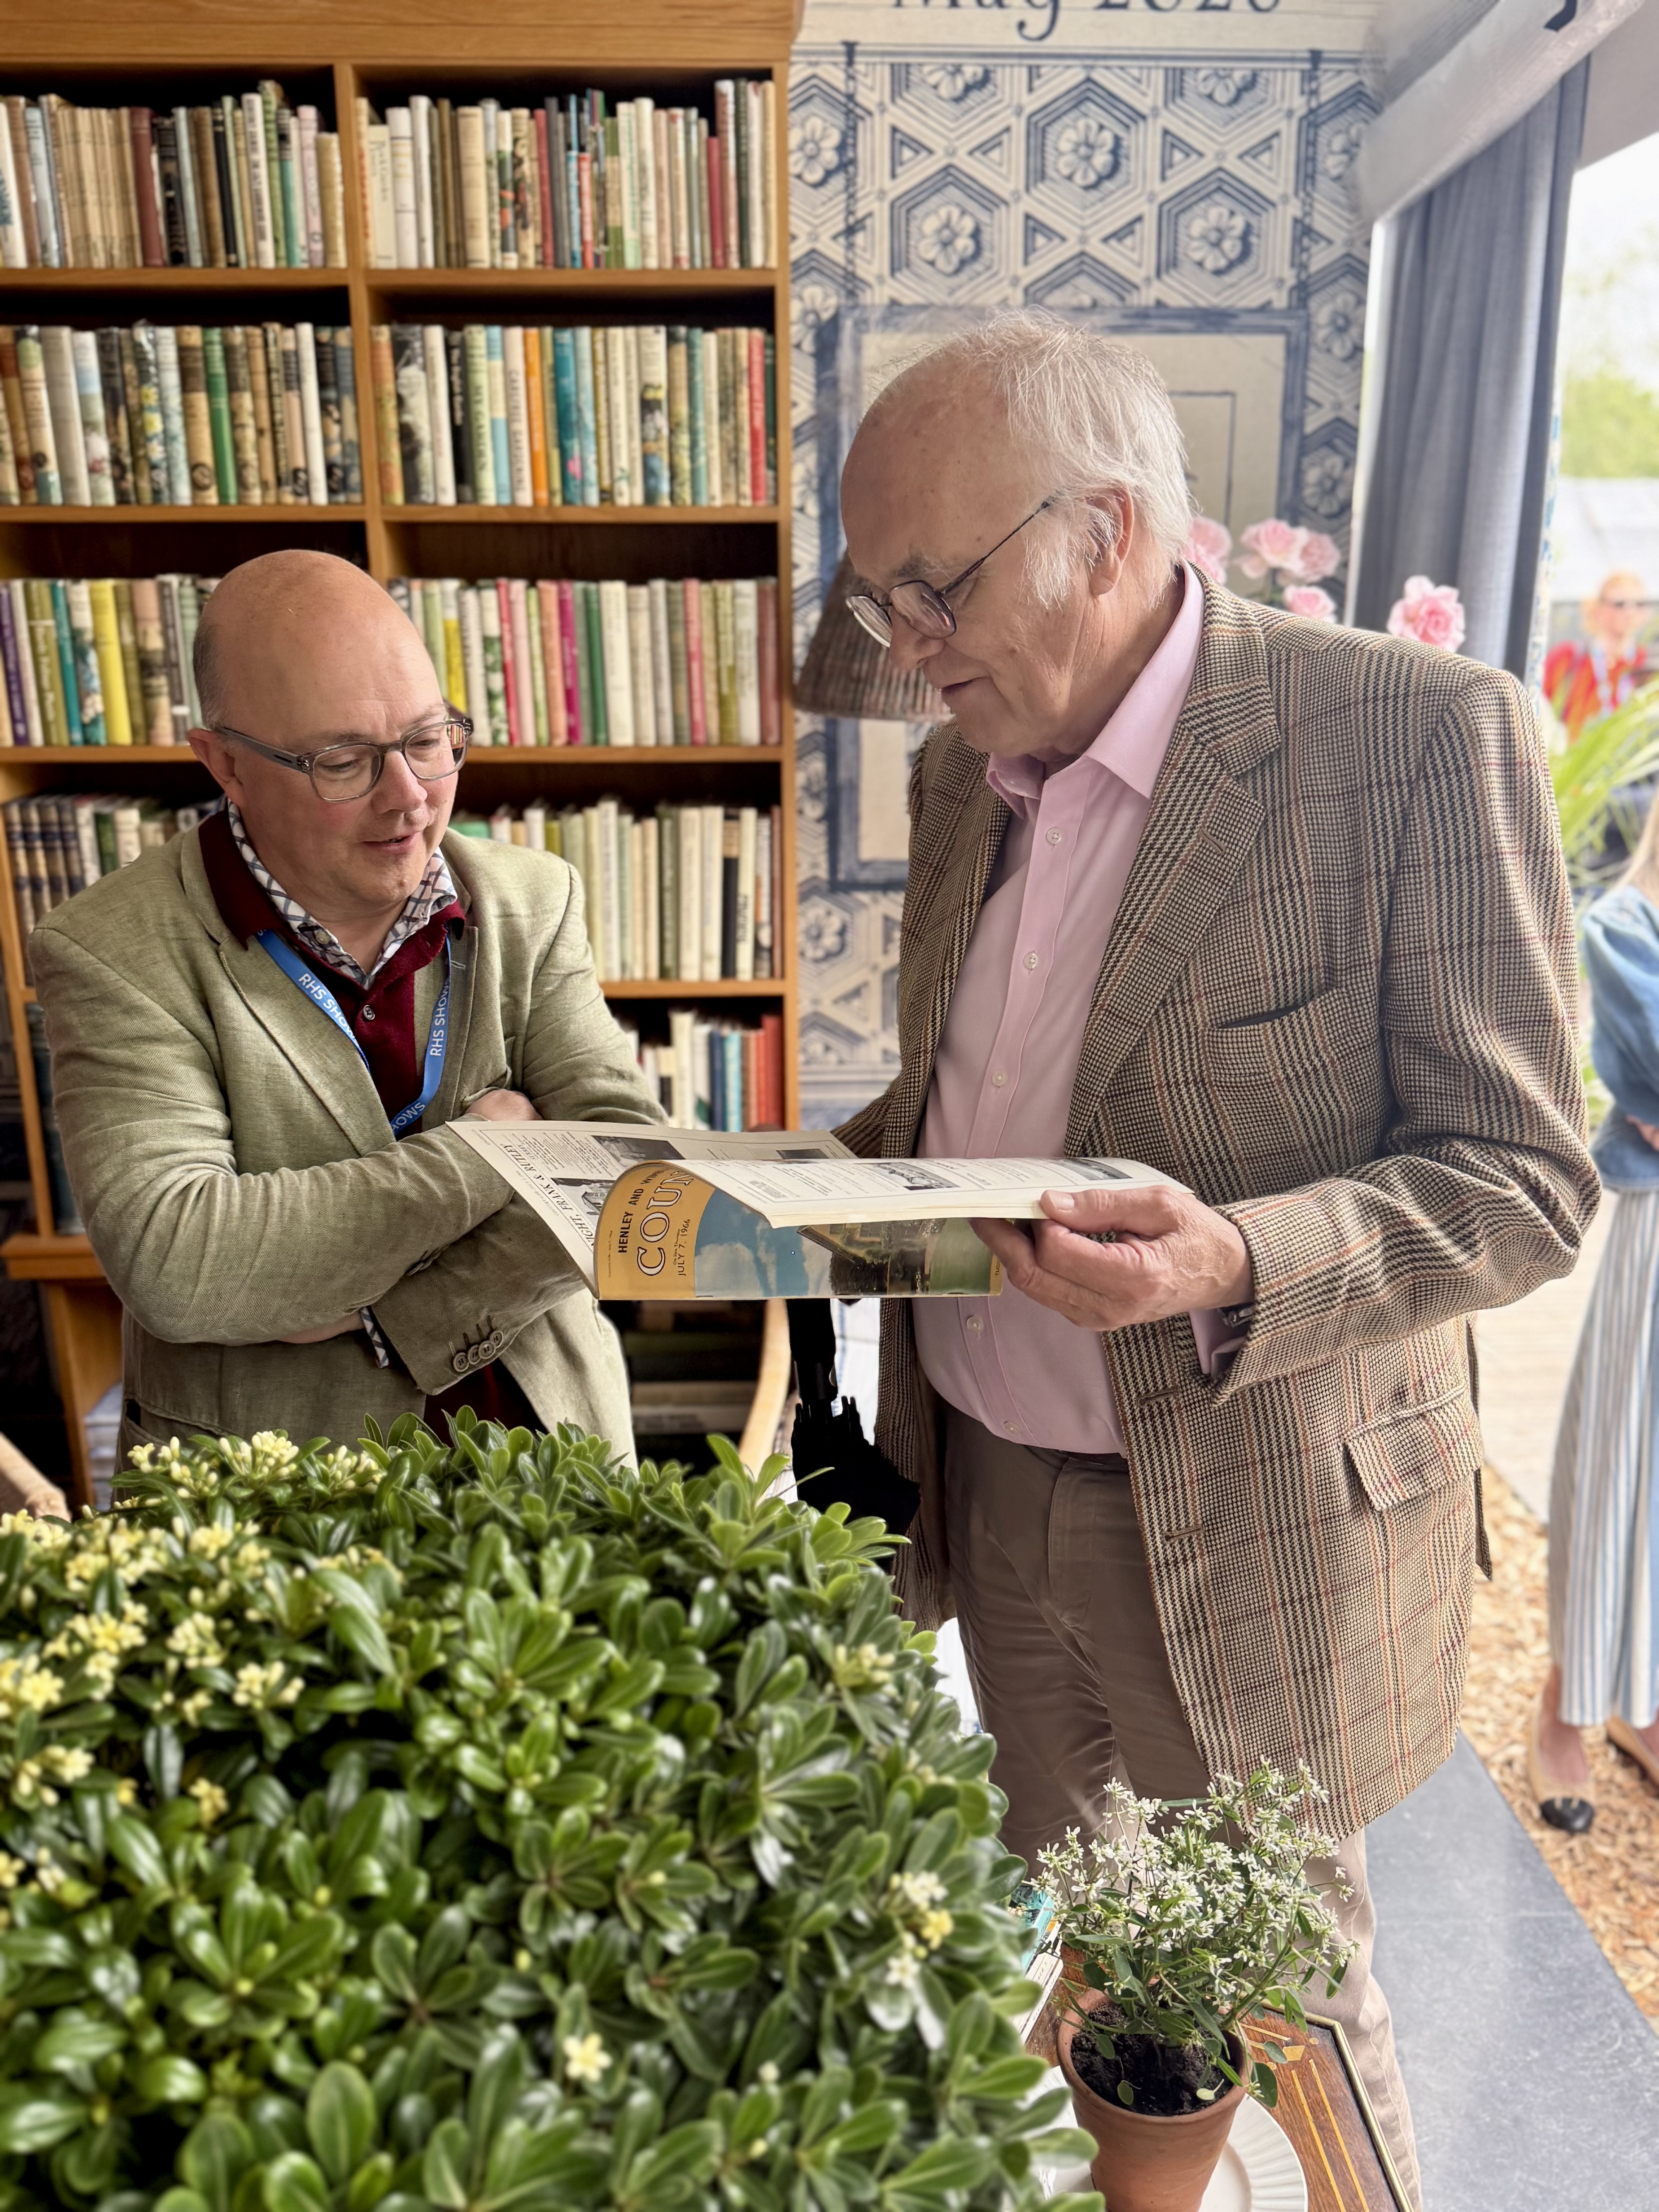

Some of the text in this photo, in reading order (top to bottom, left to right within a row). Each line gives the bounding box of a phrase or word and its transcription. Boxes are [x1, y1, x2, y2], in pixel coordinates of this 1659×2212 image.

[299, 973, 356, 1039] RHS SHOW
[429, 981, 449, 1056] RHS SHOW
[392, 1102, 426, 1132] HOWS
[500, 1144, 537, 1171] RUTLEY
[539, 1183, 573, 1211] FRANK
[618, 1211, 634, 1253] HENLEY
[628, 1188, 644, 1205] AND
[681, 1219, 690, 1236] 1966
[678, 1253, 686, 1276] JULY
